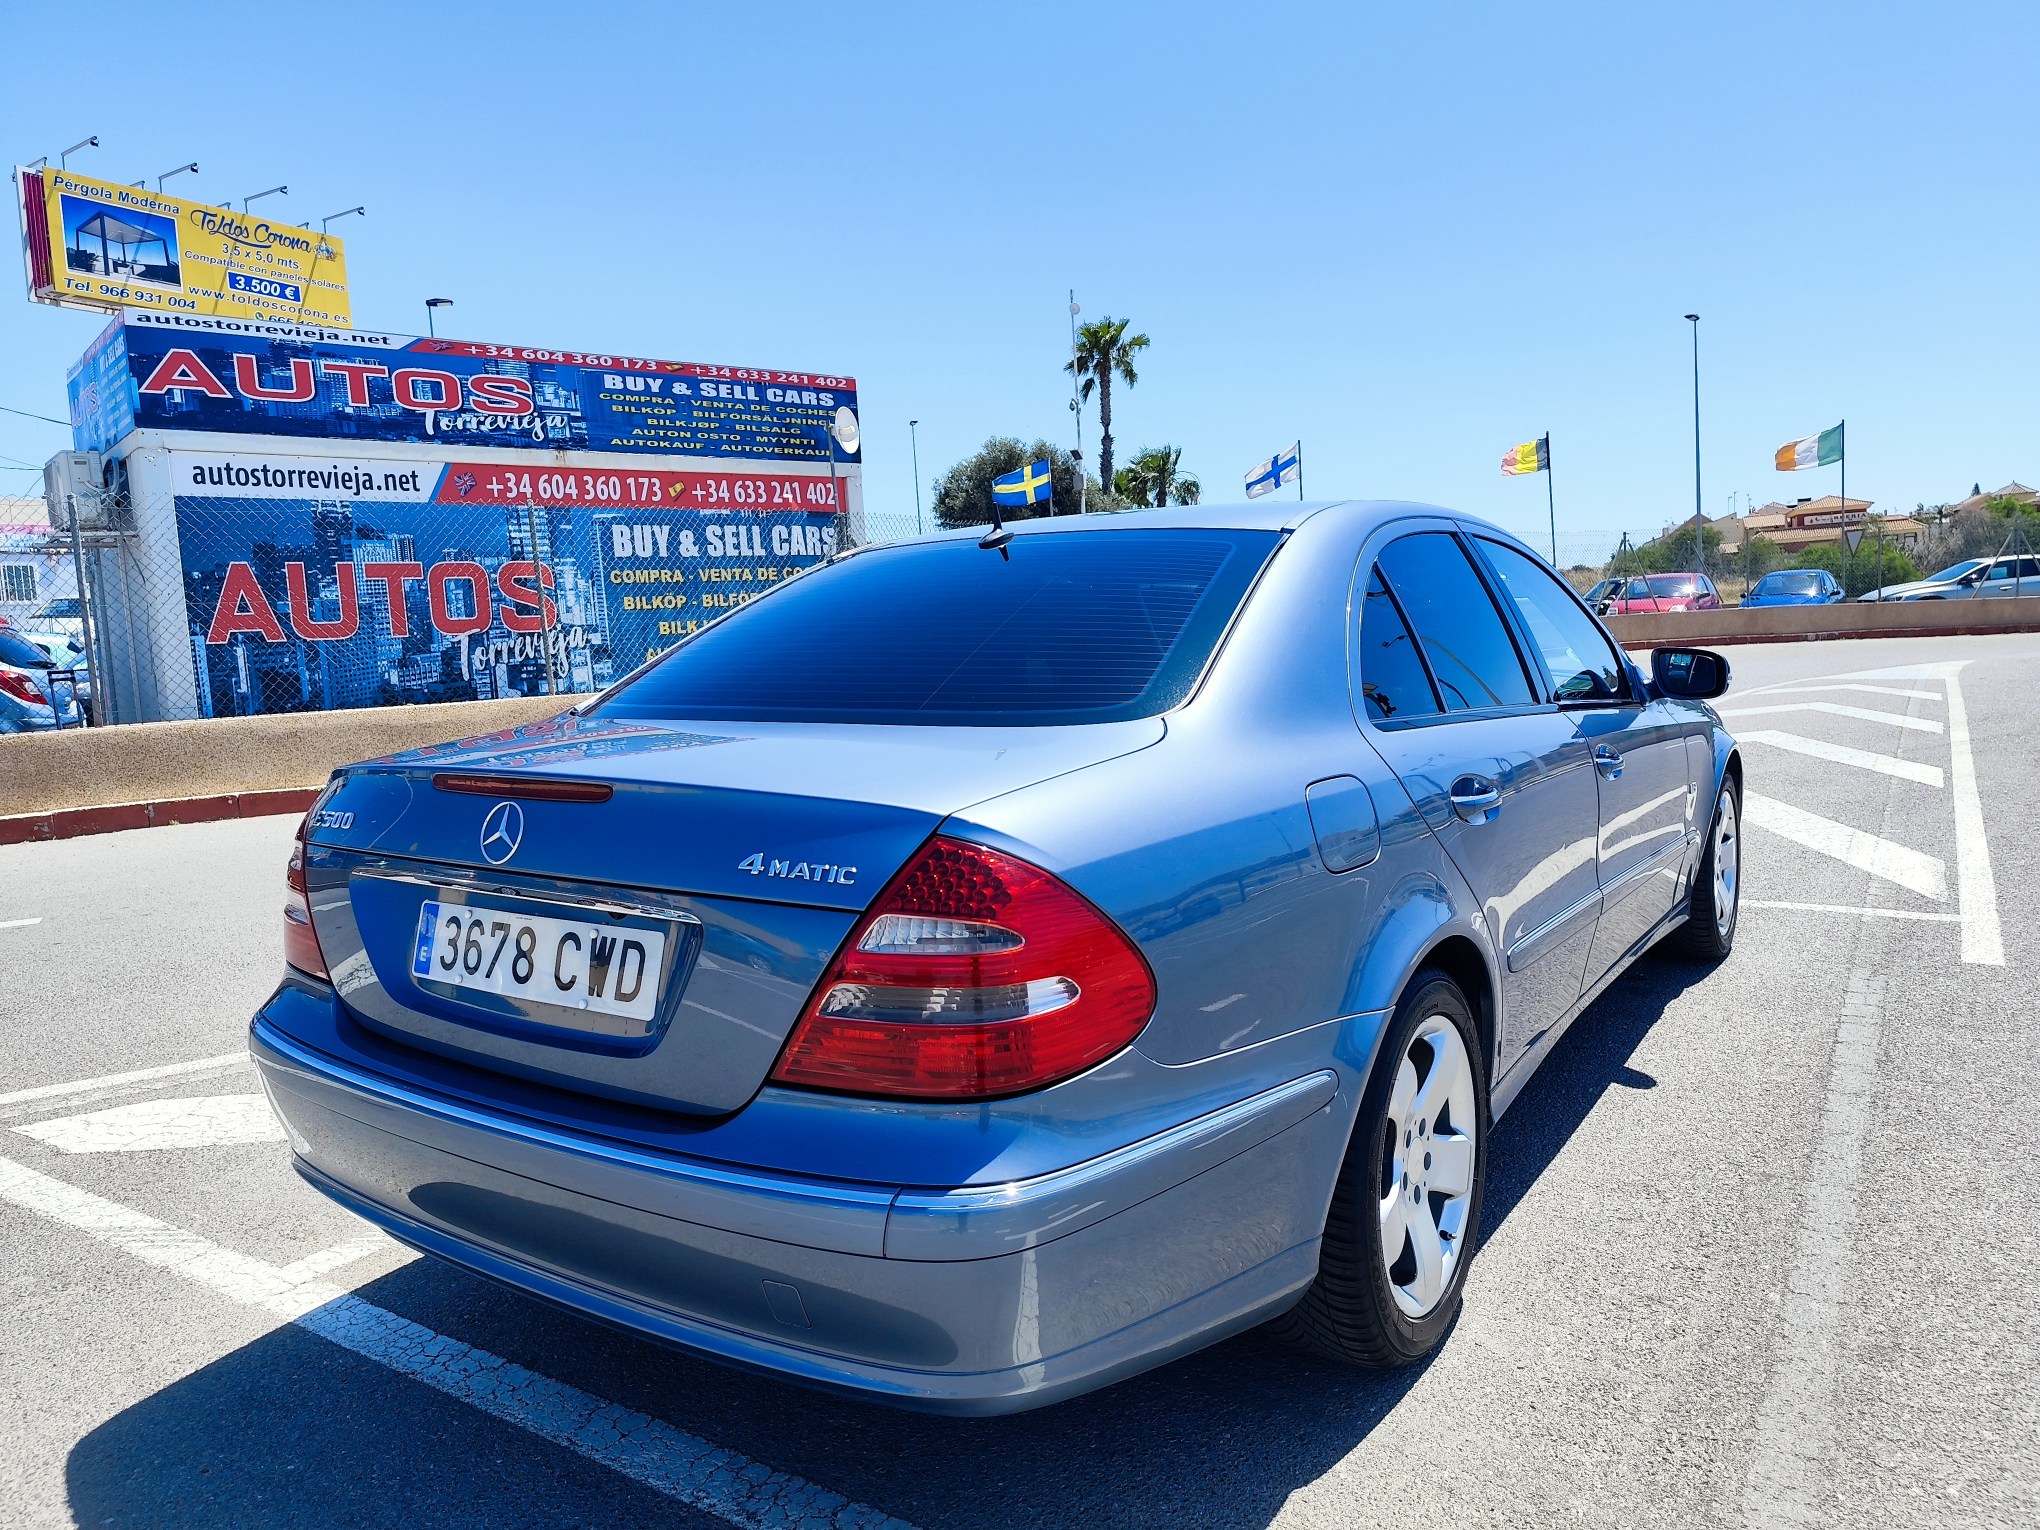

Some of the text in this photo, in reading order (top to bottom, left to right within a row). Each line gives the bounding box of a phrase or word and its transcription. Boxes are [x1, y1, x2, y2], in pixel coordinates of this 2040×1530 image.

[53, 175, 180, 214] Pérgola Moderna
[254, 223, 312, 253] Corona
[184, 250, 346, 291] Compatible con paneles solares
[222, 243, 302, 270] 3,5 x 5,0 mts.
[63, 277, 196, 310] Tel. 966 931 004
[234, 276, 296, 300] 3.500 €
[188, 286, 349, 324] www.toldoscorona.es
[136, 312, 392, 346] autostorrevieja.net
[138, 348, 535, 416] AUTOS
[464, 345, 848, 388] +34 604 360 173 +34 633 241 402
[599, 393, 675, 405] COMPRA
[690, 400, 745, 410] VENTA
[750, 404, 771, 412] DE
[776, 406, 836, 417] COCHES
[602, 374, 834, 407] BUY & SELL CARS
[415, 409, 568, 442] Torrevieja
[611, 405, 677, 416] BILKÖP
[692, 410, 827, 426] BILFÖRSÄLJNING
[647, 418, 720, 429] BILKJØP
[735, 424, 801, 435] BILSALG
[610, 438, 704, 450] AUTOKAUF
[632, 428, 691, 438] AUTON
[697, 432, 741, 441] OSTO
[756, 436, 815, 446] MYYNTI
[192, 464, 421, 496] autostorrevieja.net
[486, 473, 836, 505] +34 604 360 173 +34 633 241 402
[611, 524, 837, 558] BUY & SELL CARS
[610, 569, 684, 584] COMPRA
[699, 568, 753, 582] VENTA
[757, 567, 778, 581] DE
[206, 561, 558, 645] AUTOS
[624, 592, 688, 610] BILKÖP
[451, 624, 592, 682] Torrevieja
[312, 811, 355, 829] E500
[419, 946, 429, 962] E
[440, 915, 646, 1003] 3678 CWD
